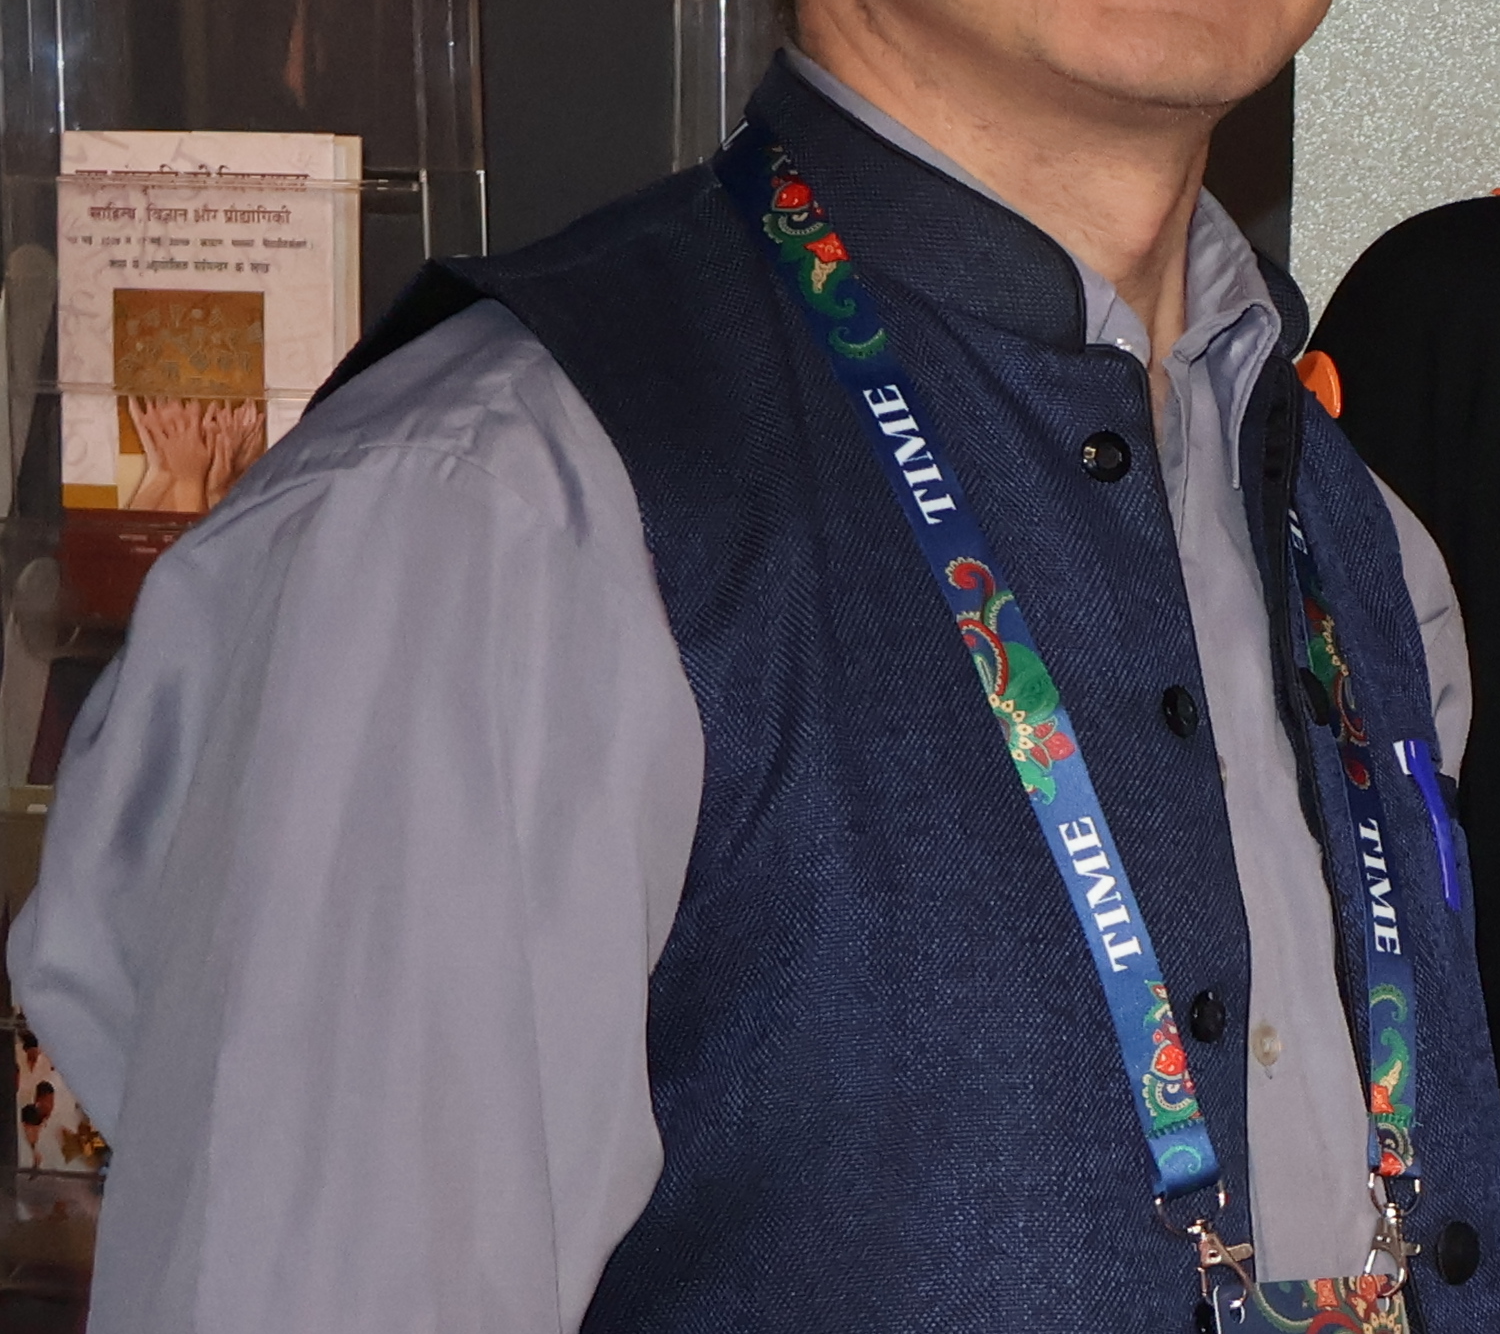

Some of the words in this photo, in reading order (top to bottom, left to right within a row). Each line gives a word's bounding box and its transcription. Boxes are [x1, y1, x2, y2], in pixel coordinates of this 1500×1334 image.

[194, 204, 218, 223] और
[863, 383, 955, 526] TIME
[1060, 814, 1140, 972] TIME
[1358, 818, 1400, 955] TIME
